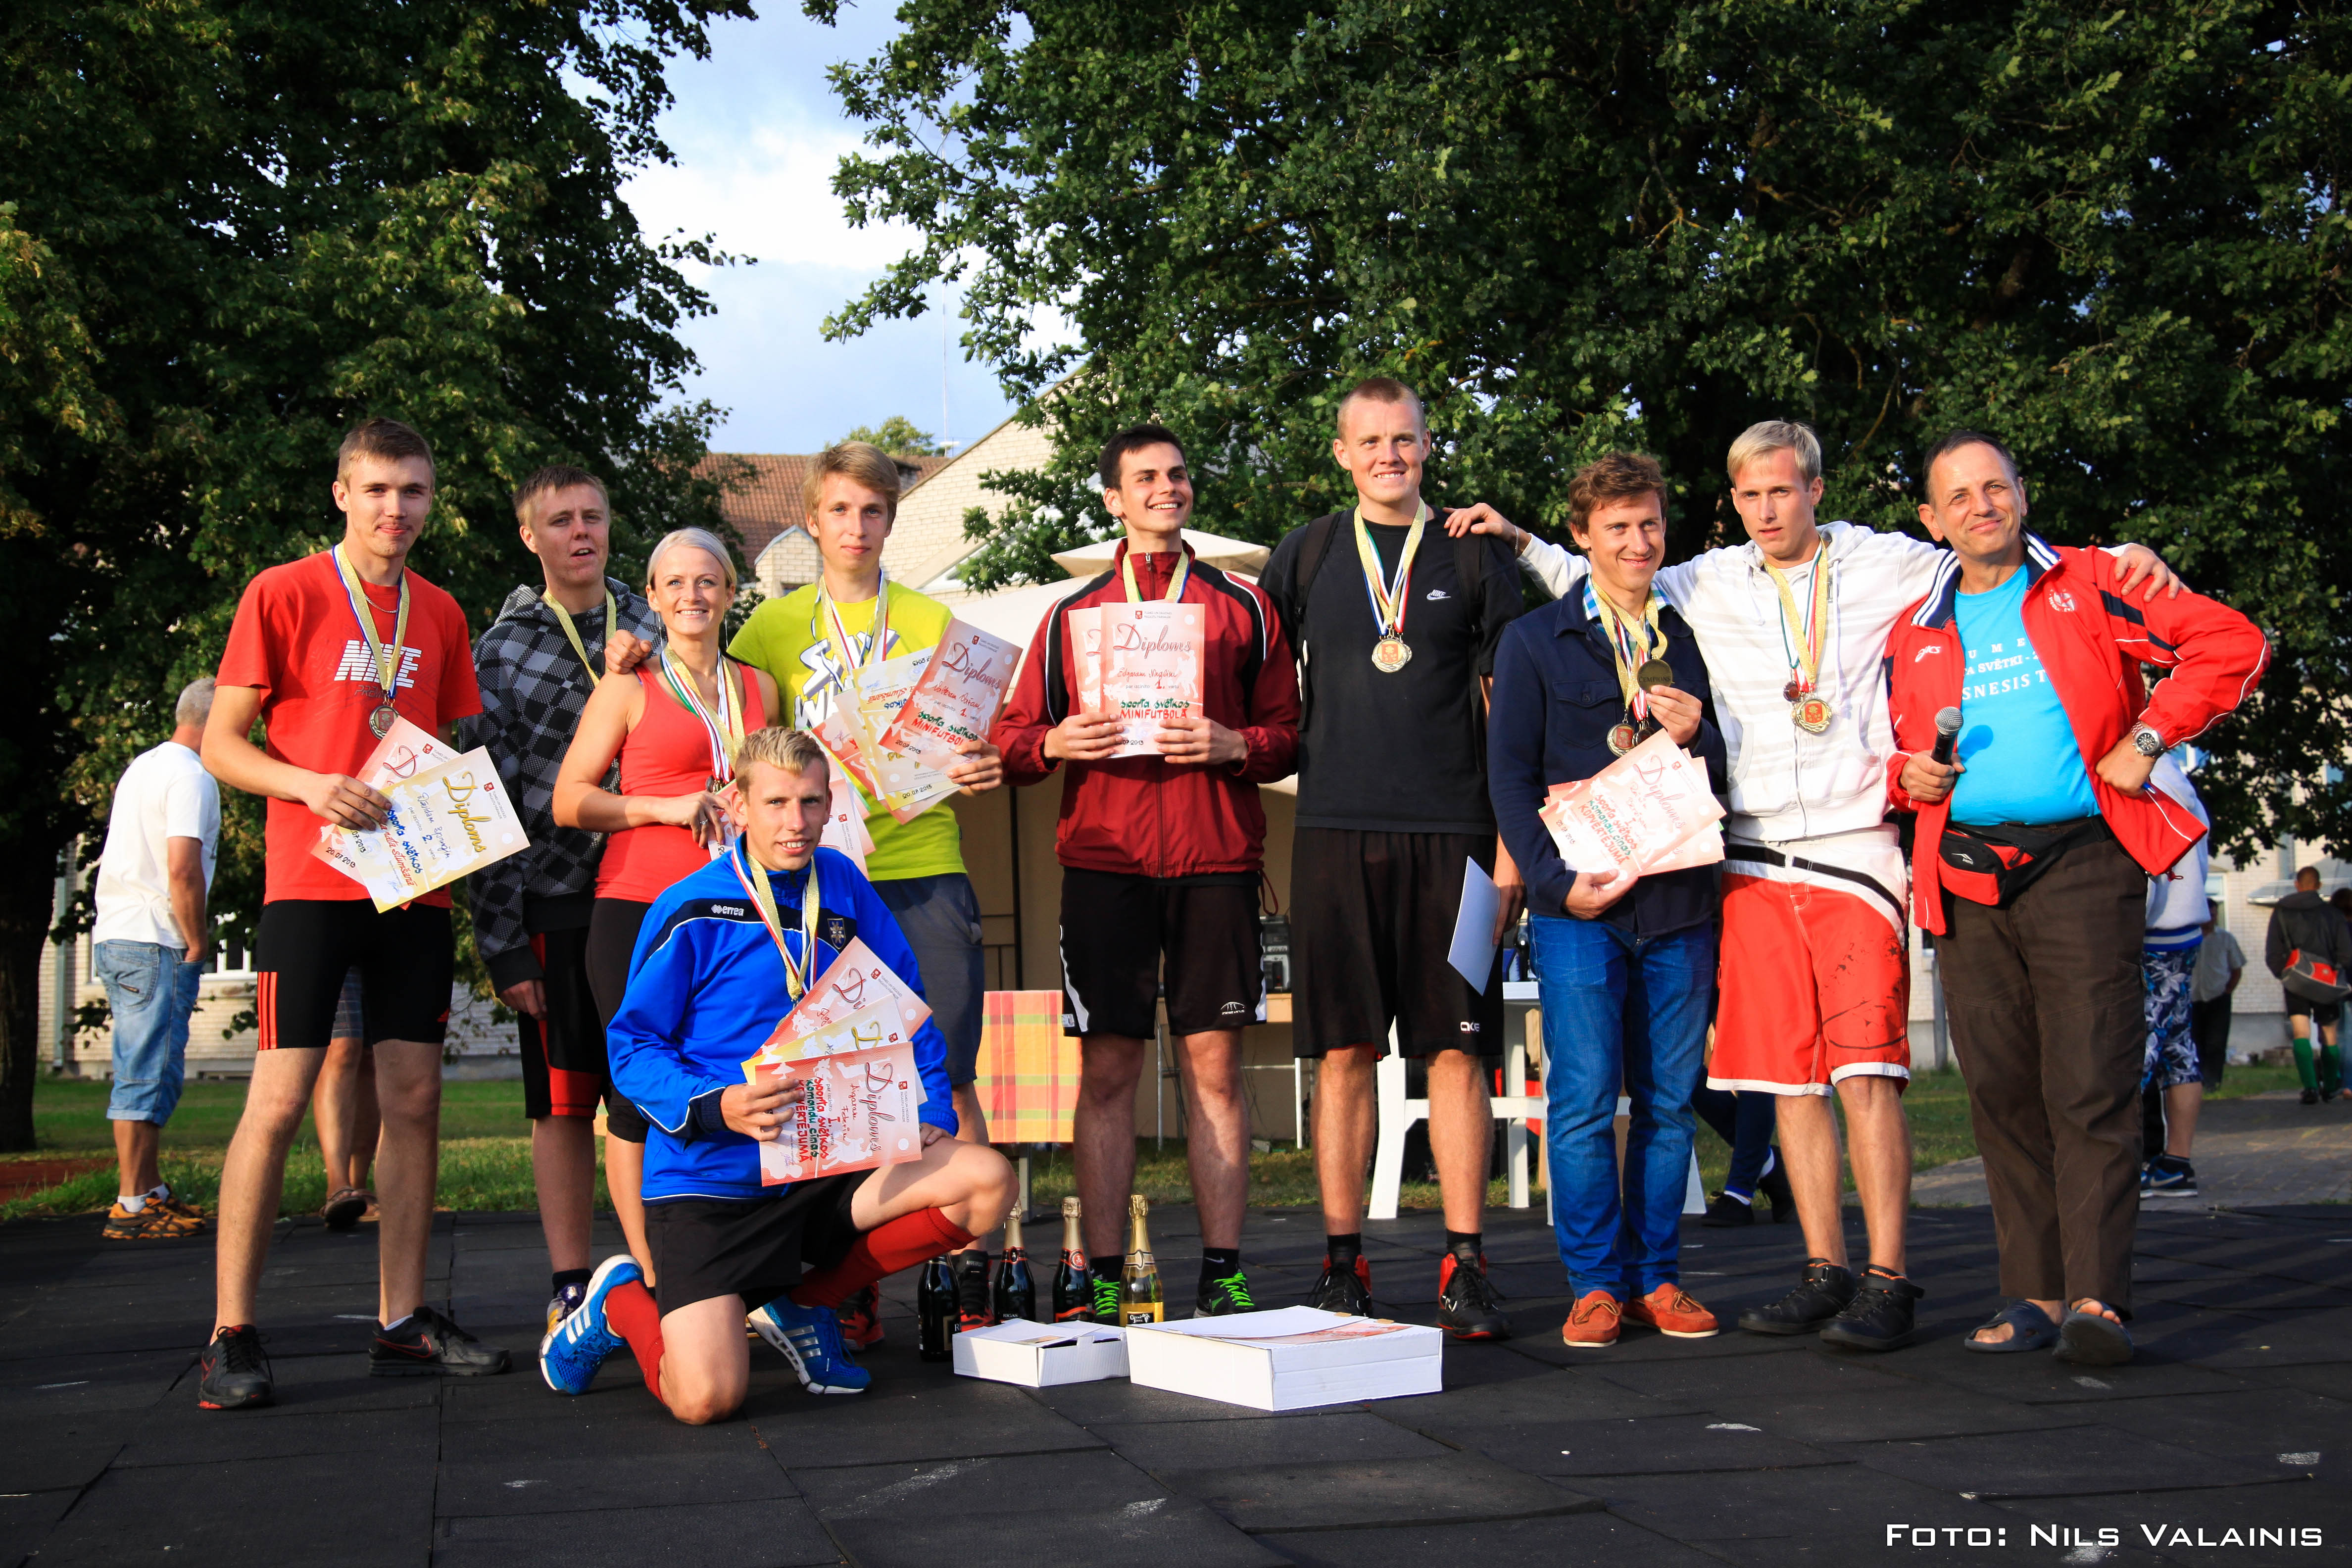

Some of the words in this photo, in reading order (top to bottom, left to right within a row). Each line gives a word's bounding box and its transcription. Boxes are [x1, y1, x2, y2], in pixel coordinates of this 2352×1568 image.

[1113, 623, 1191, 659] Diploms
[942, 642, 1001, 688] Diploms
[1978, 655, 2023, 673] SVĒTKI
[918, 710, 945, 727] sporta
[1120, 708, 1188, 719] MINIFUTBOLĀ
[1121, 698, 1149, 710] sporta
[1154, 698, 1190, 709] svētkos
[1595, 794, 1616, 820] sporta
[1633, 755, 1686, 828] Diploms
[443, 771, 487, 852] Diploms
[387, 809, 406, 836] sporta
[403, 840, 423, 874] svētkos
[422, 834, 433, 844] 2.
[814, 1077, 828, 1112] sporta
[859, 1062, 896, 1151] Diploms
[818, 1116, 830, 1159] svētkos
